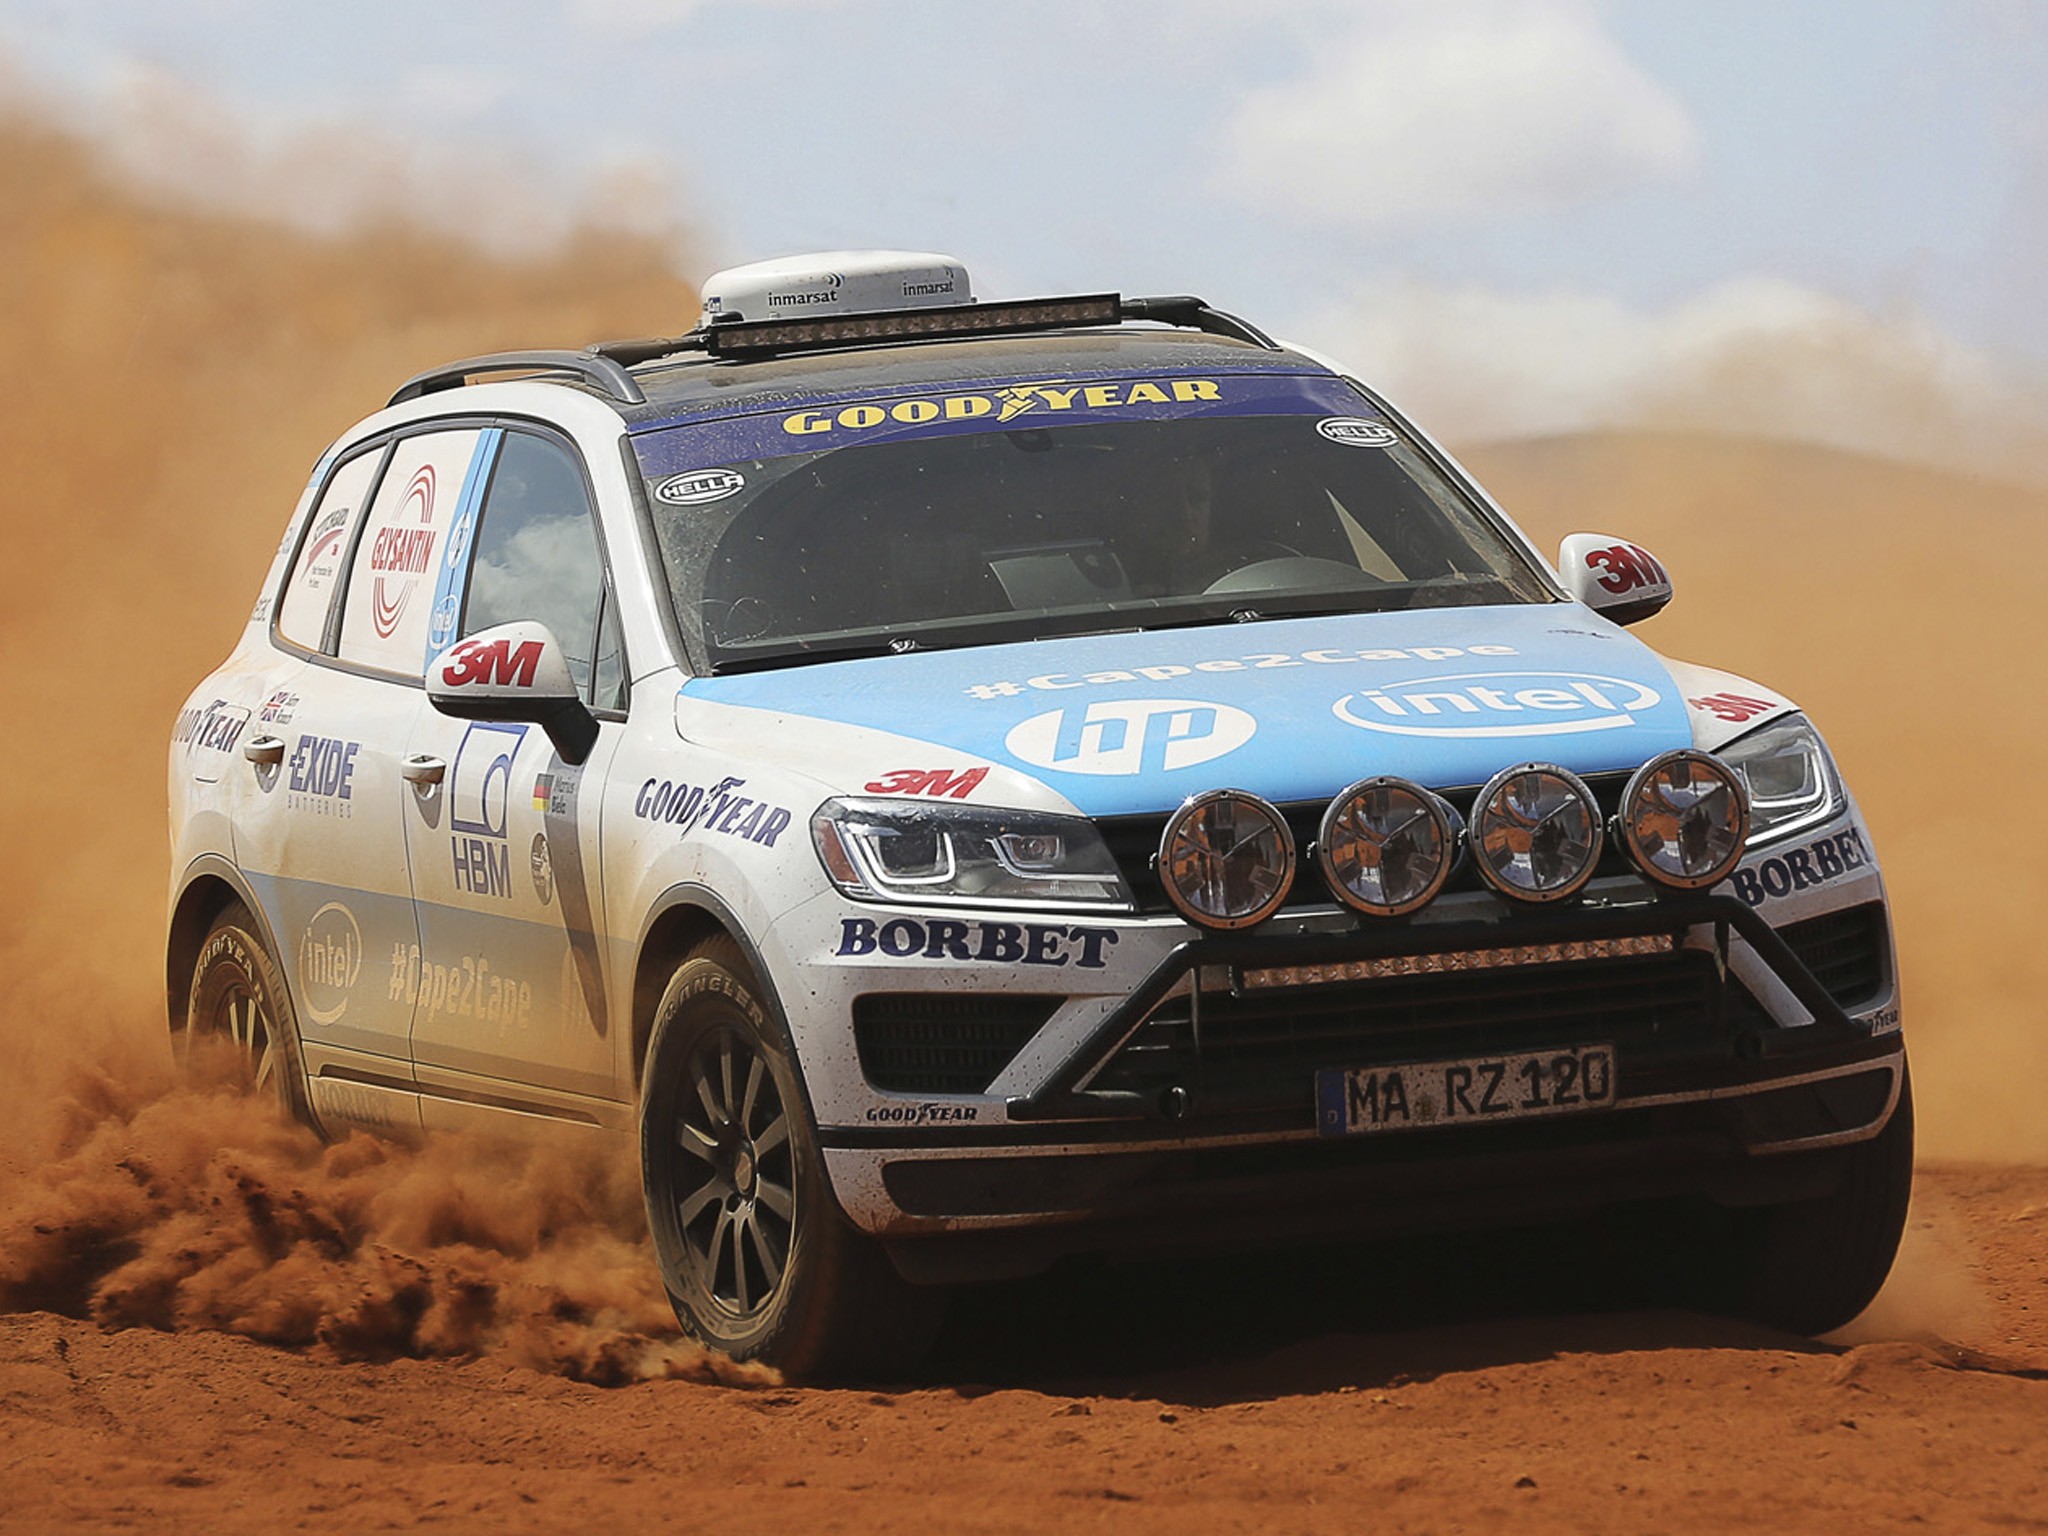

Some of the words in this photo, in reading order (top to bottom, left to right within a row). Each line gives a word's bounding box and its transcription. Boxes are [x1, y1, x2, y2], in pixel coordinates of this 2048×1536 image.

[768, 289, 838, 307] inmarsat
[903, 280, 954, 297] inmarsat
[1324, 426, 1399, 440] HELLA
[663, 473, 746, 498] HELLA
[371, 527, 437, 574] GLYSANTIN
[1586, 544, 1668, 594] 3M
[442, 639, 545, 688] 3M
[963, 643, 1520, 700] #Cape2Cape
[1361, 681, 1618, 716] intel
[1688, 692, 1778, 722] 3M
[1053, 702, 1218, 775] hp
[289, 734, 360, 799] EXIDE
[864, 766, 990, 799] 3M
[452, 836, 513, 899] HBM
[306, 927, 352, 989] intel
[836, 918, 1120, 968] BORBET
[1349, 1071, 1410, 1124] MA
[1445, 1063, 1509, 1116] RZ
[1520, 1051, 1610, 1109] 120
